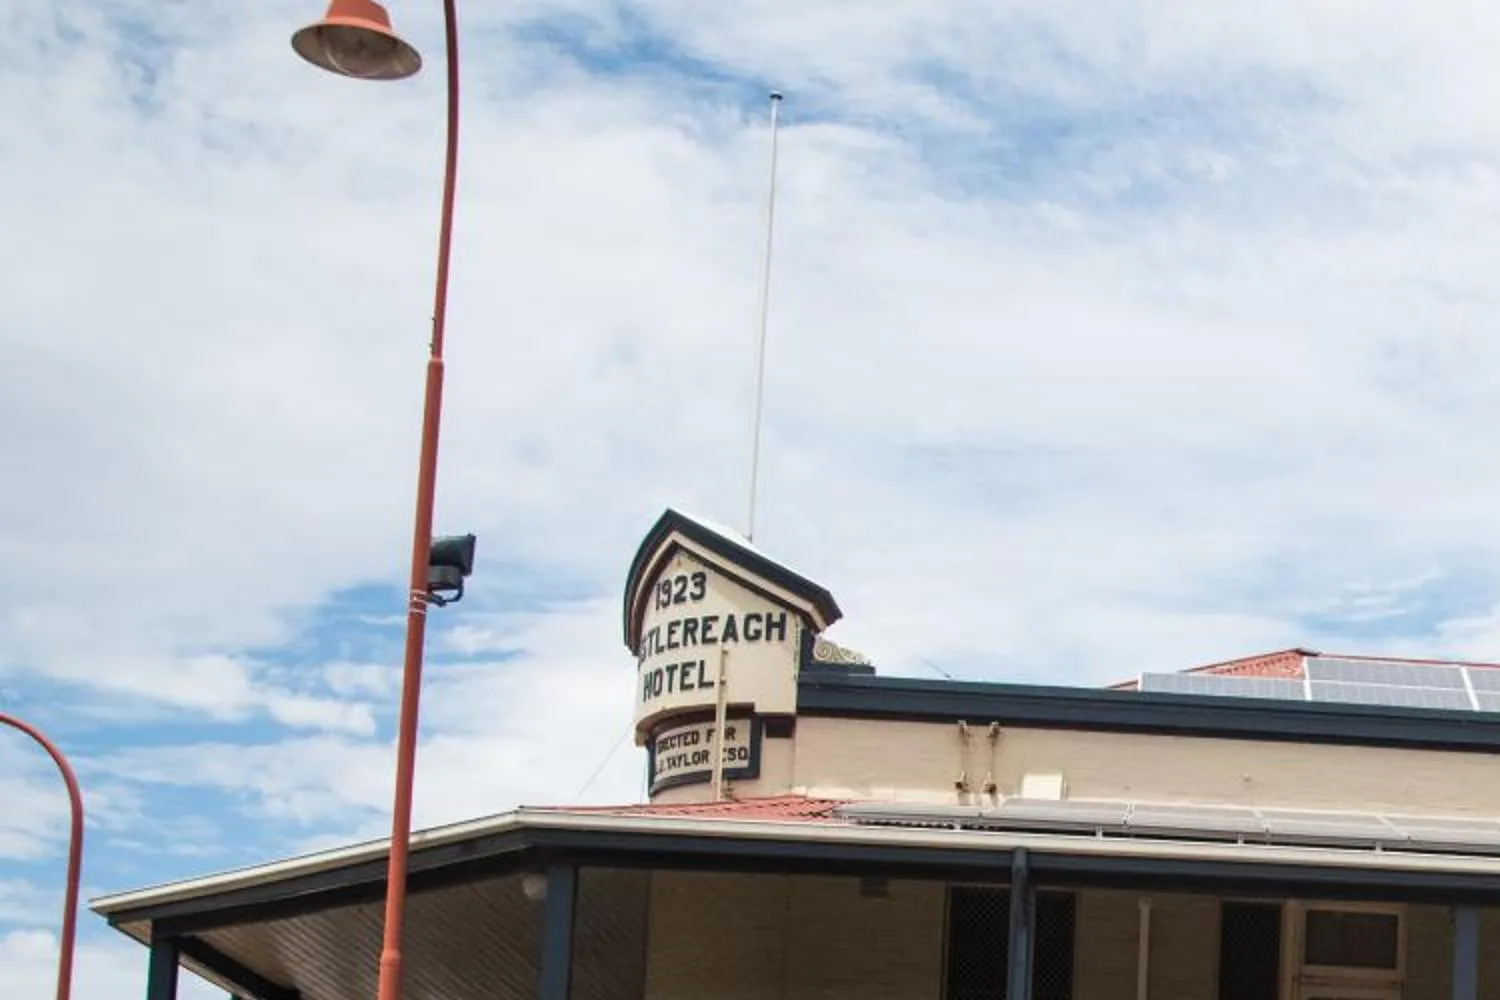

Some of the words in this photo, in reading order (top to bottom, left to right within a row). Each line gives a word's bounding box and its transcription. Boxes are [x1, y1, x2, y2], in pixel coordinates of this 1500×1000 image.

[656, 571, 707, 611] 1923
[638, 612, 787, 664] STLEREAGH
[643, 659, 715, 702] HOTEL
[706, 726, 736, 743] FR
[667, 749, 710, 770] TAYLOR
